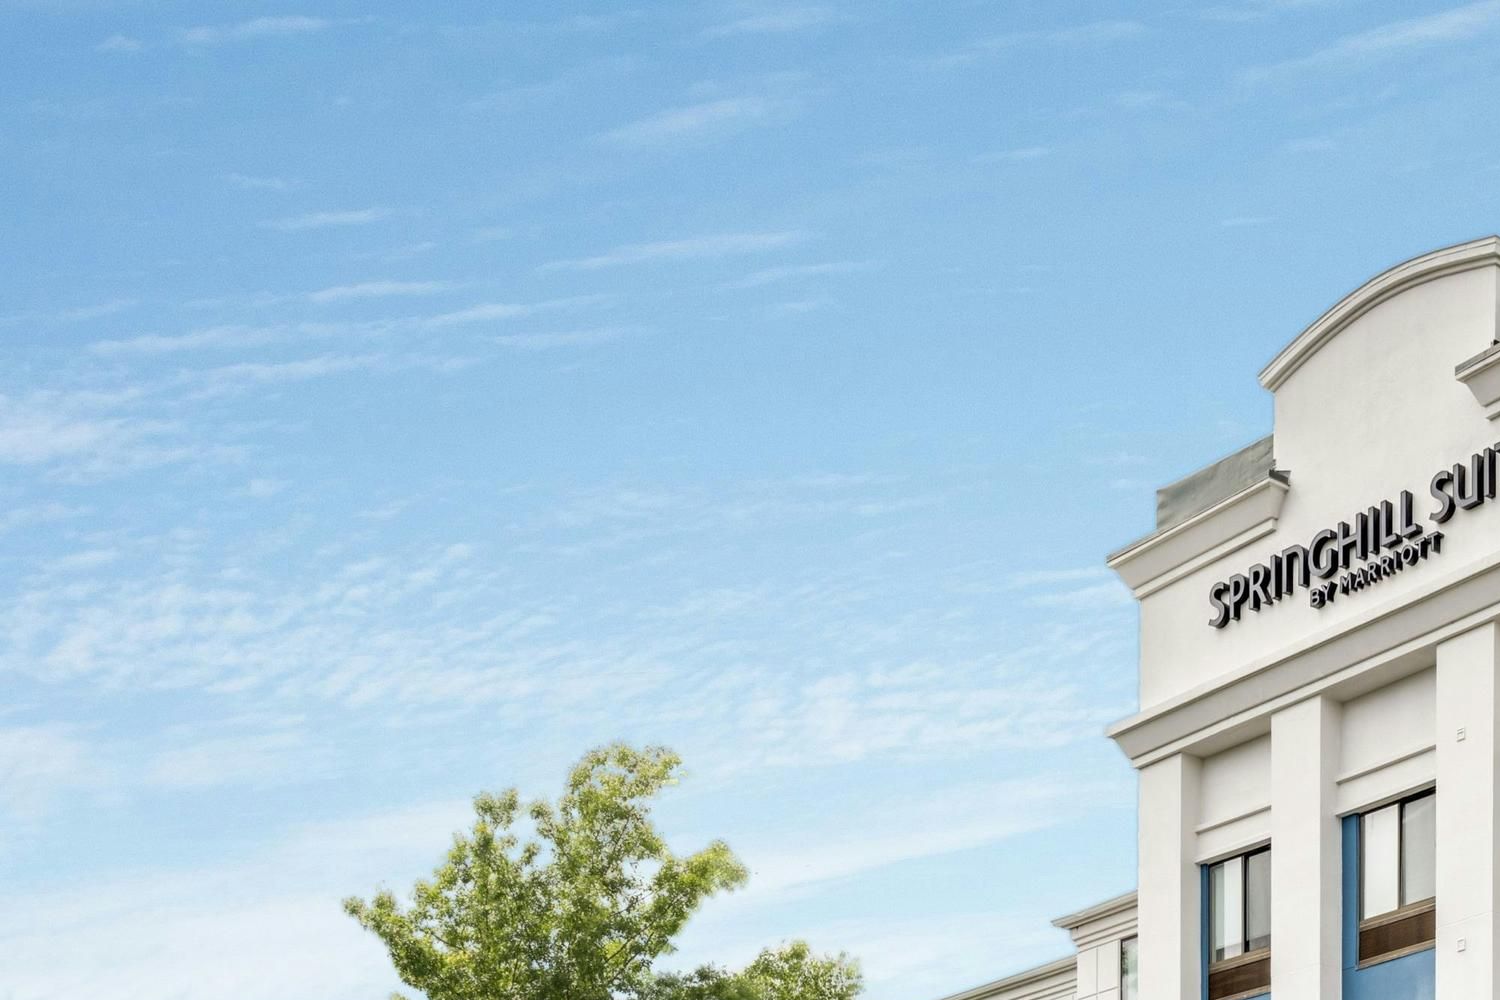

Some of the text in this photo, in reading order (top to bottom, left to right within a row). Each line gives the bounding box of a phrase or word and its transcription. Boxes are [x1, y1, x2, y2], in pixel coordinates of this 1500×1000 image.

[1208, 489, 1424, 629] SPRINGHILL
[1310, 530, 1445, 610] BY MARRIOTT
